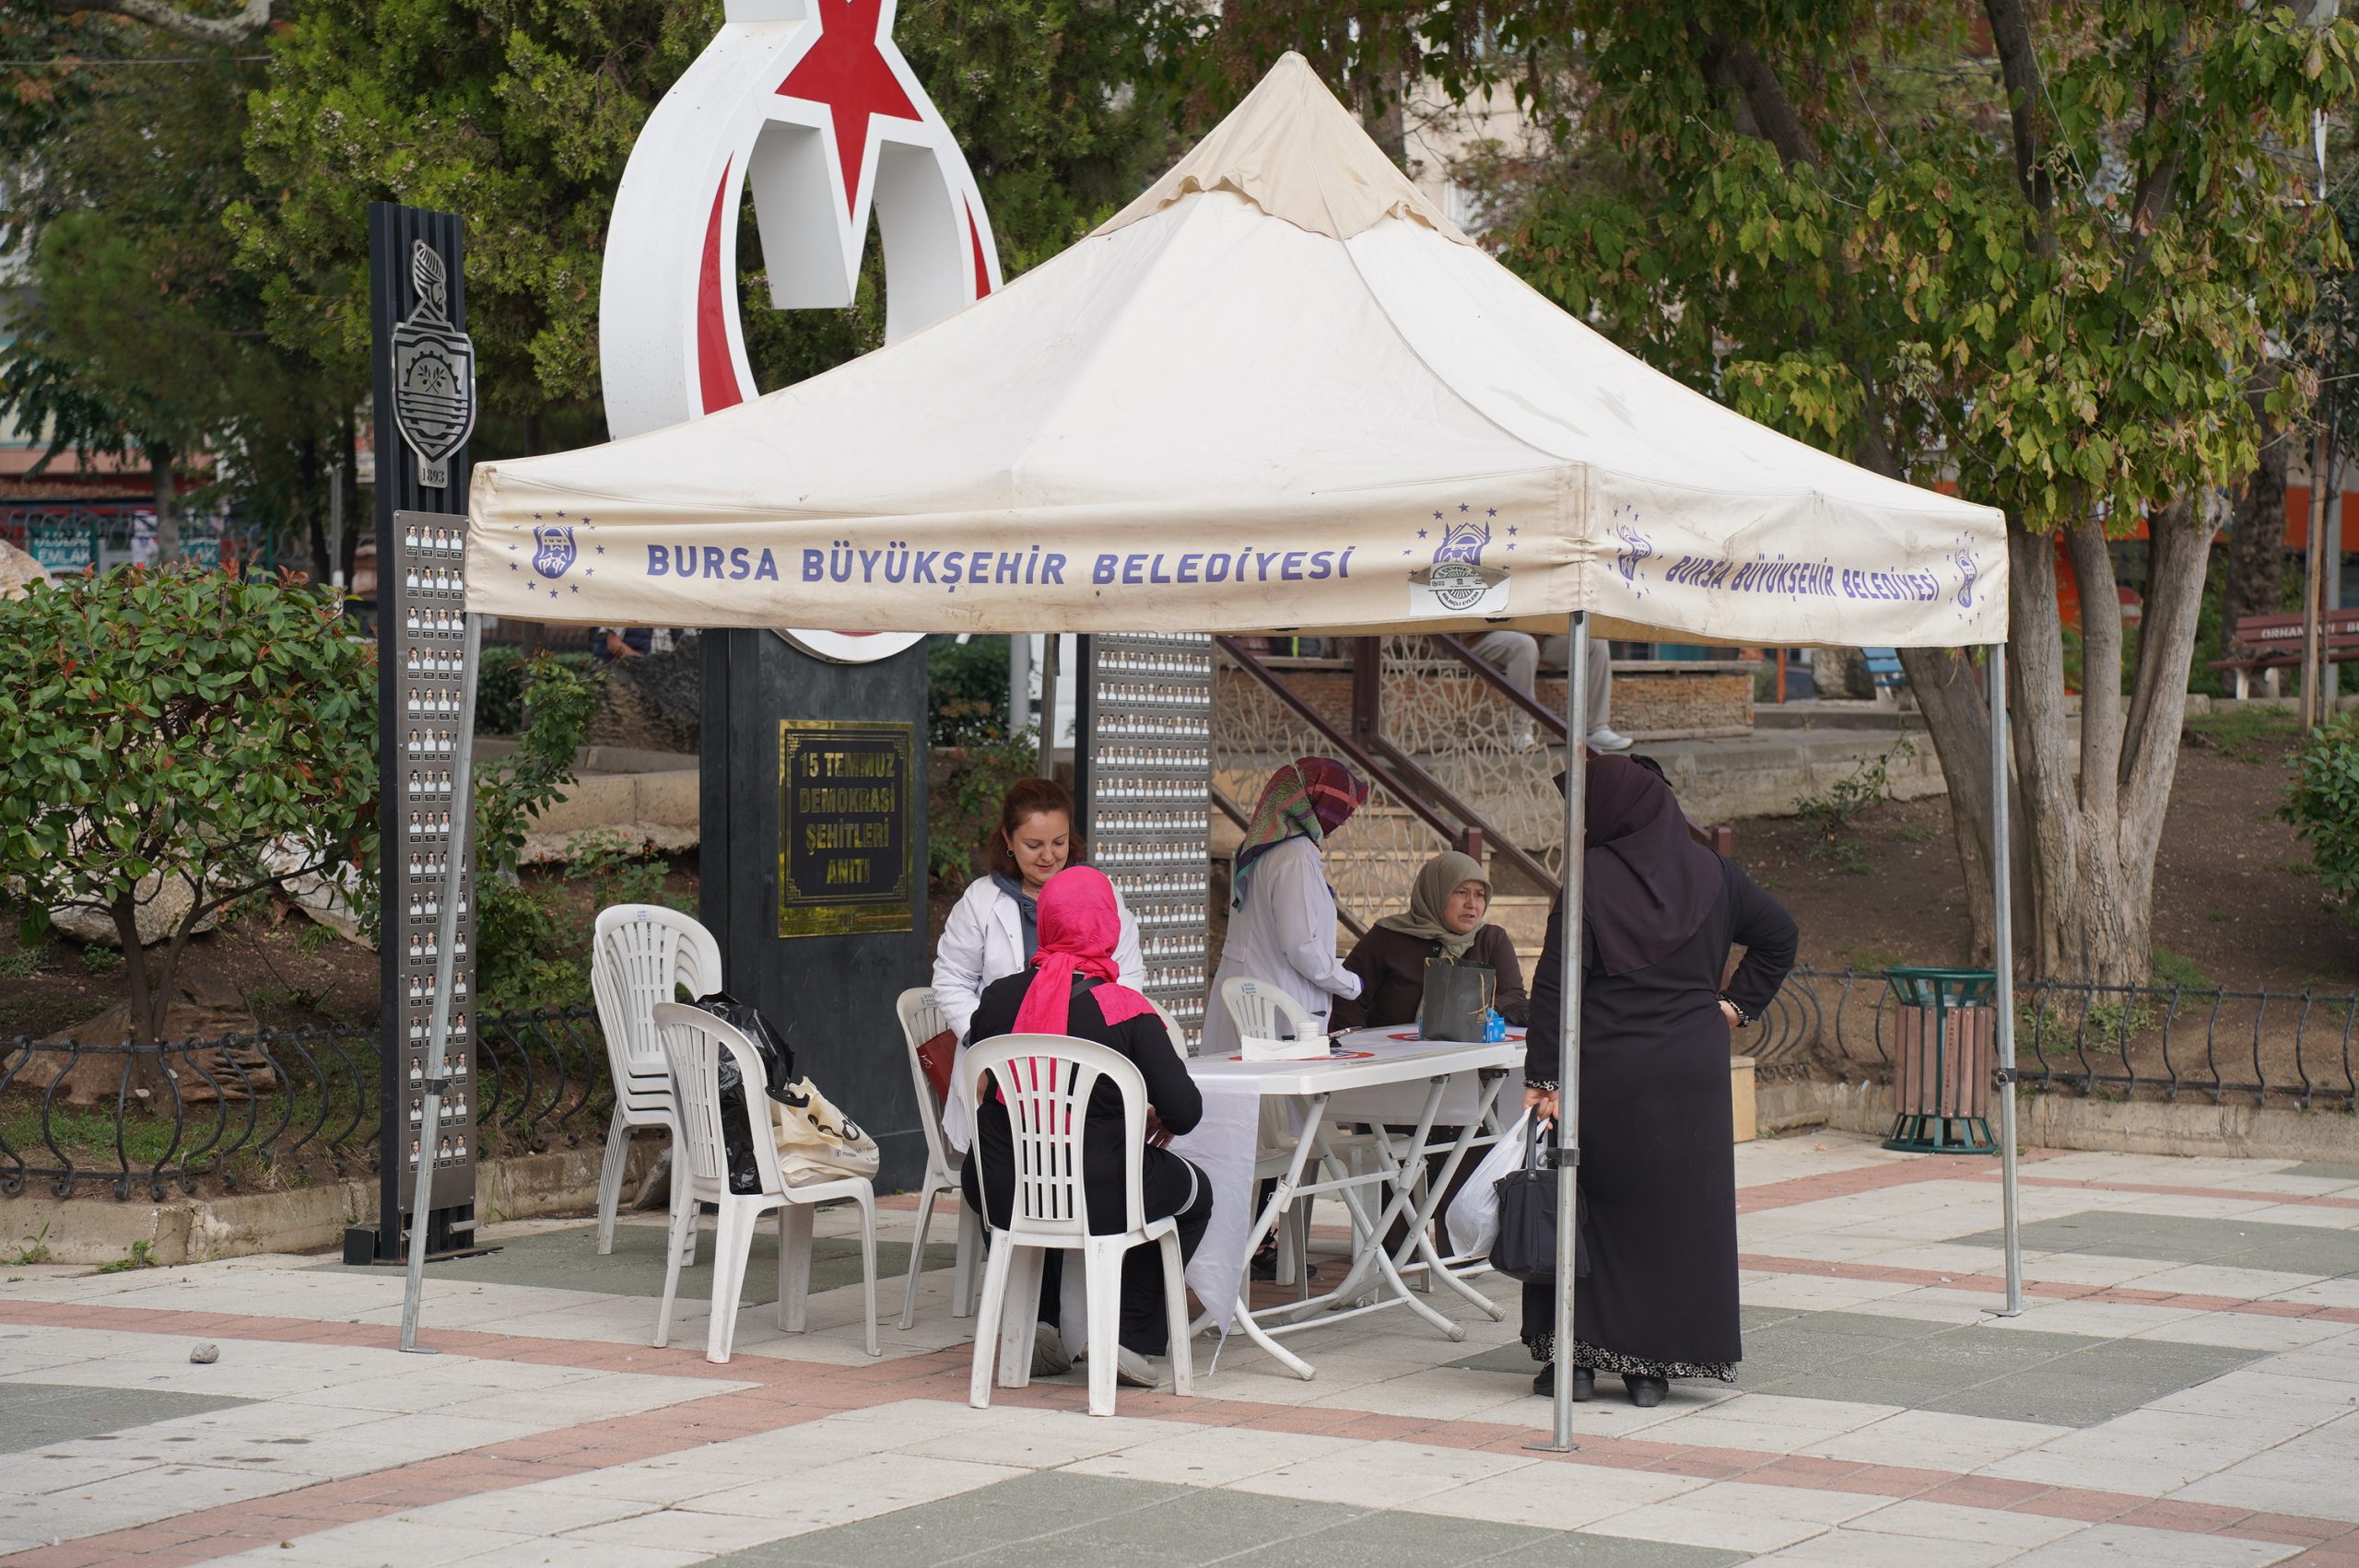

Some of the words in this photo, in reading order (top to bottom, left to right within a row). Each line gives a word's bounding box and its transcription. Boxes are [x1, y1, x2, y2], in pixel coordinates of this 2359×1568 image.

[421, 468, 444, 483] 1893
[38, 548, 90, 564] EMLAK
[647, 544, 779, 580] BURSA
[802, 540, 1067, 592] BÜYÜKŞEHİR
[1092, 545, 1356, 584] BELEDİYESİ
[1665, 556, 1733, 590] BURSA
[1731, 553, 1837, 602] BÜYÜKŞEHİR
[1843, 567, 1939, 601] BELEDİYESİ
[800, 752, 819, 778] 15
[824, 752, 896, 778] TEMMUZ
[799, 782, 896, 813] DEMOKRASİ
[805, 817, 889, 855] ŞEHİTLERİ
